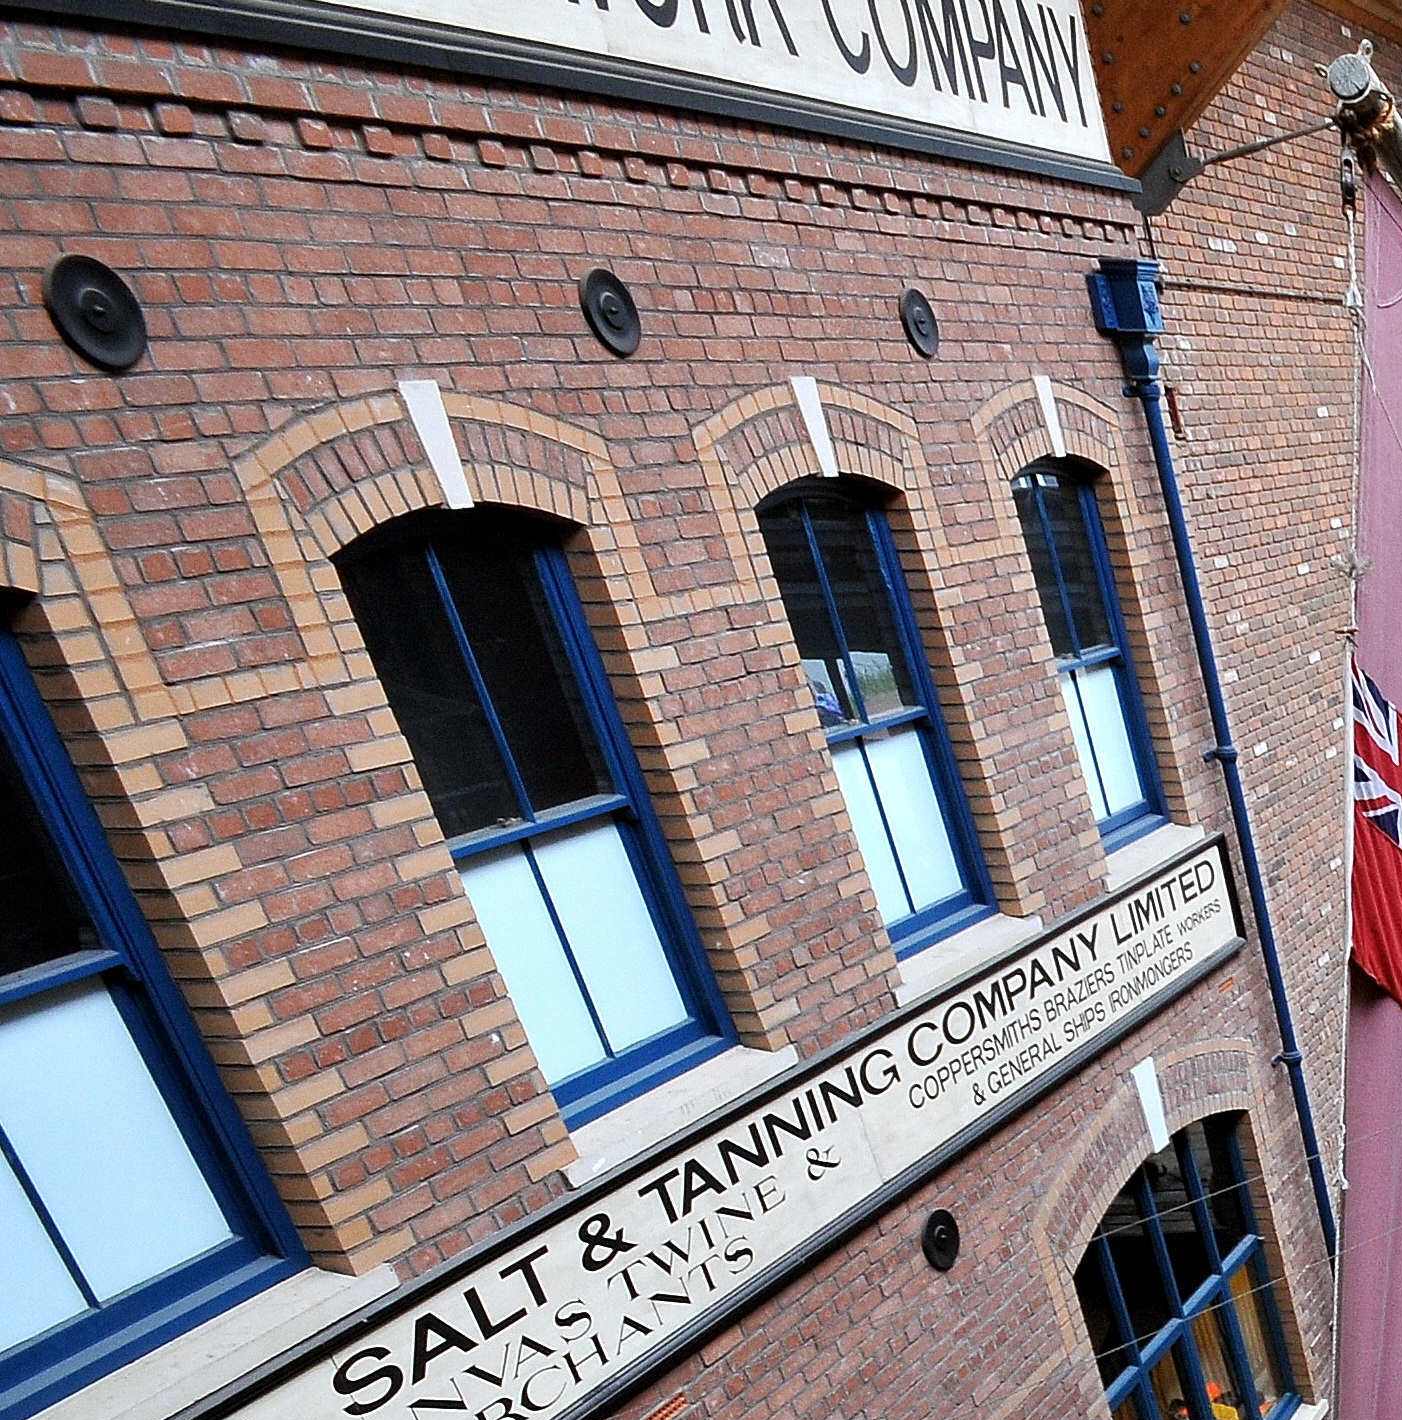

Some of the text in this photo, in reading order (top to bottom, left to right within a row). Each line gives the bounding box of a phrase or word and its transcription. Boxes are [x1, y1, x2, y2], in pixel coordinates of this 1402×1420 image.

[825, 0, 1088, 127] COMPANY
[908, 899, 1221, 1109] COPPERSMITHS BRAZIERS TINPLATE WORKERS
[972, 942, 1194, 1106] & GENERAL SHIPS IRONMONGERS
[332, 1245, 551, 1416] SALT
[578, 1213, 638, 1272] &
[638, 1048, 901, 1224] TANNING
[907, 923, 1099, 1067] COMPANY
[1110, 859, 1215, 945] LIMITED
[608, 1175, 786, 1300] TWINE
[806, 1146, 842, 1181] &
